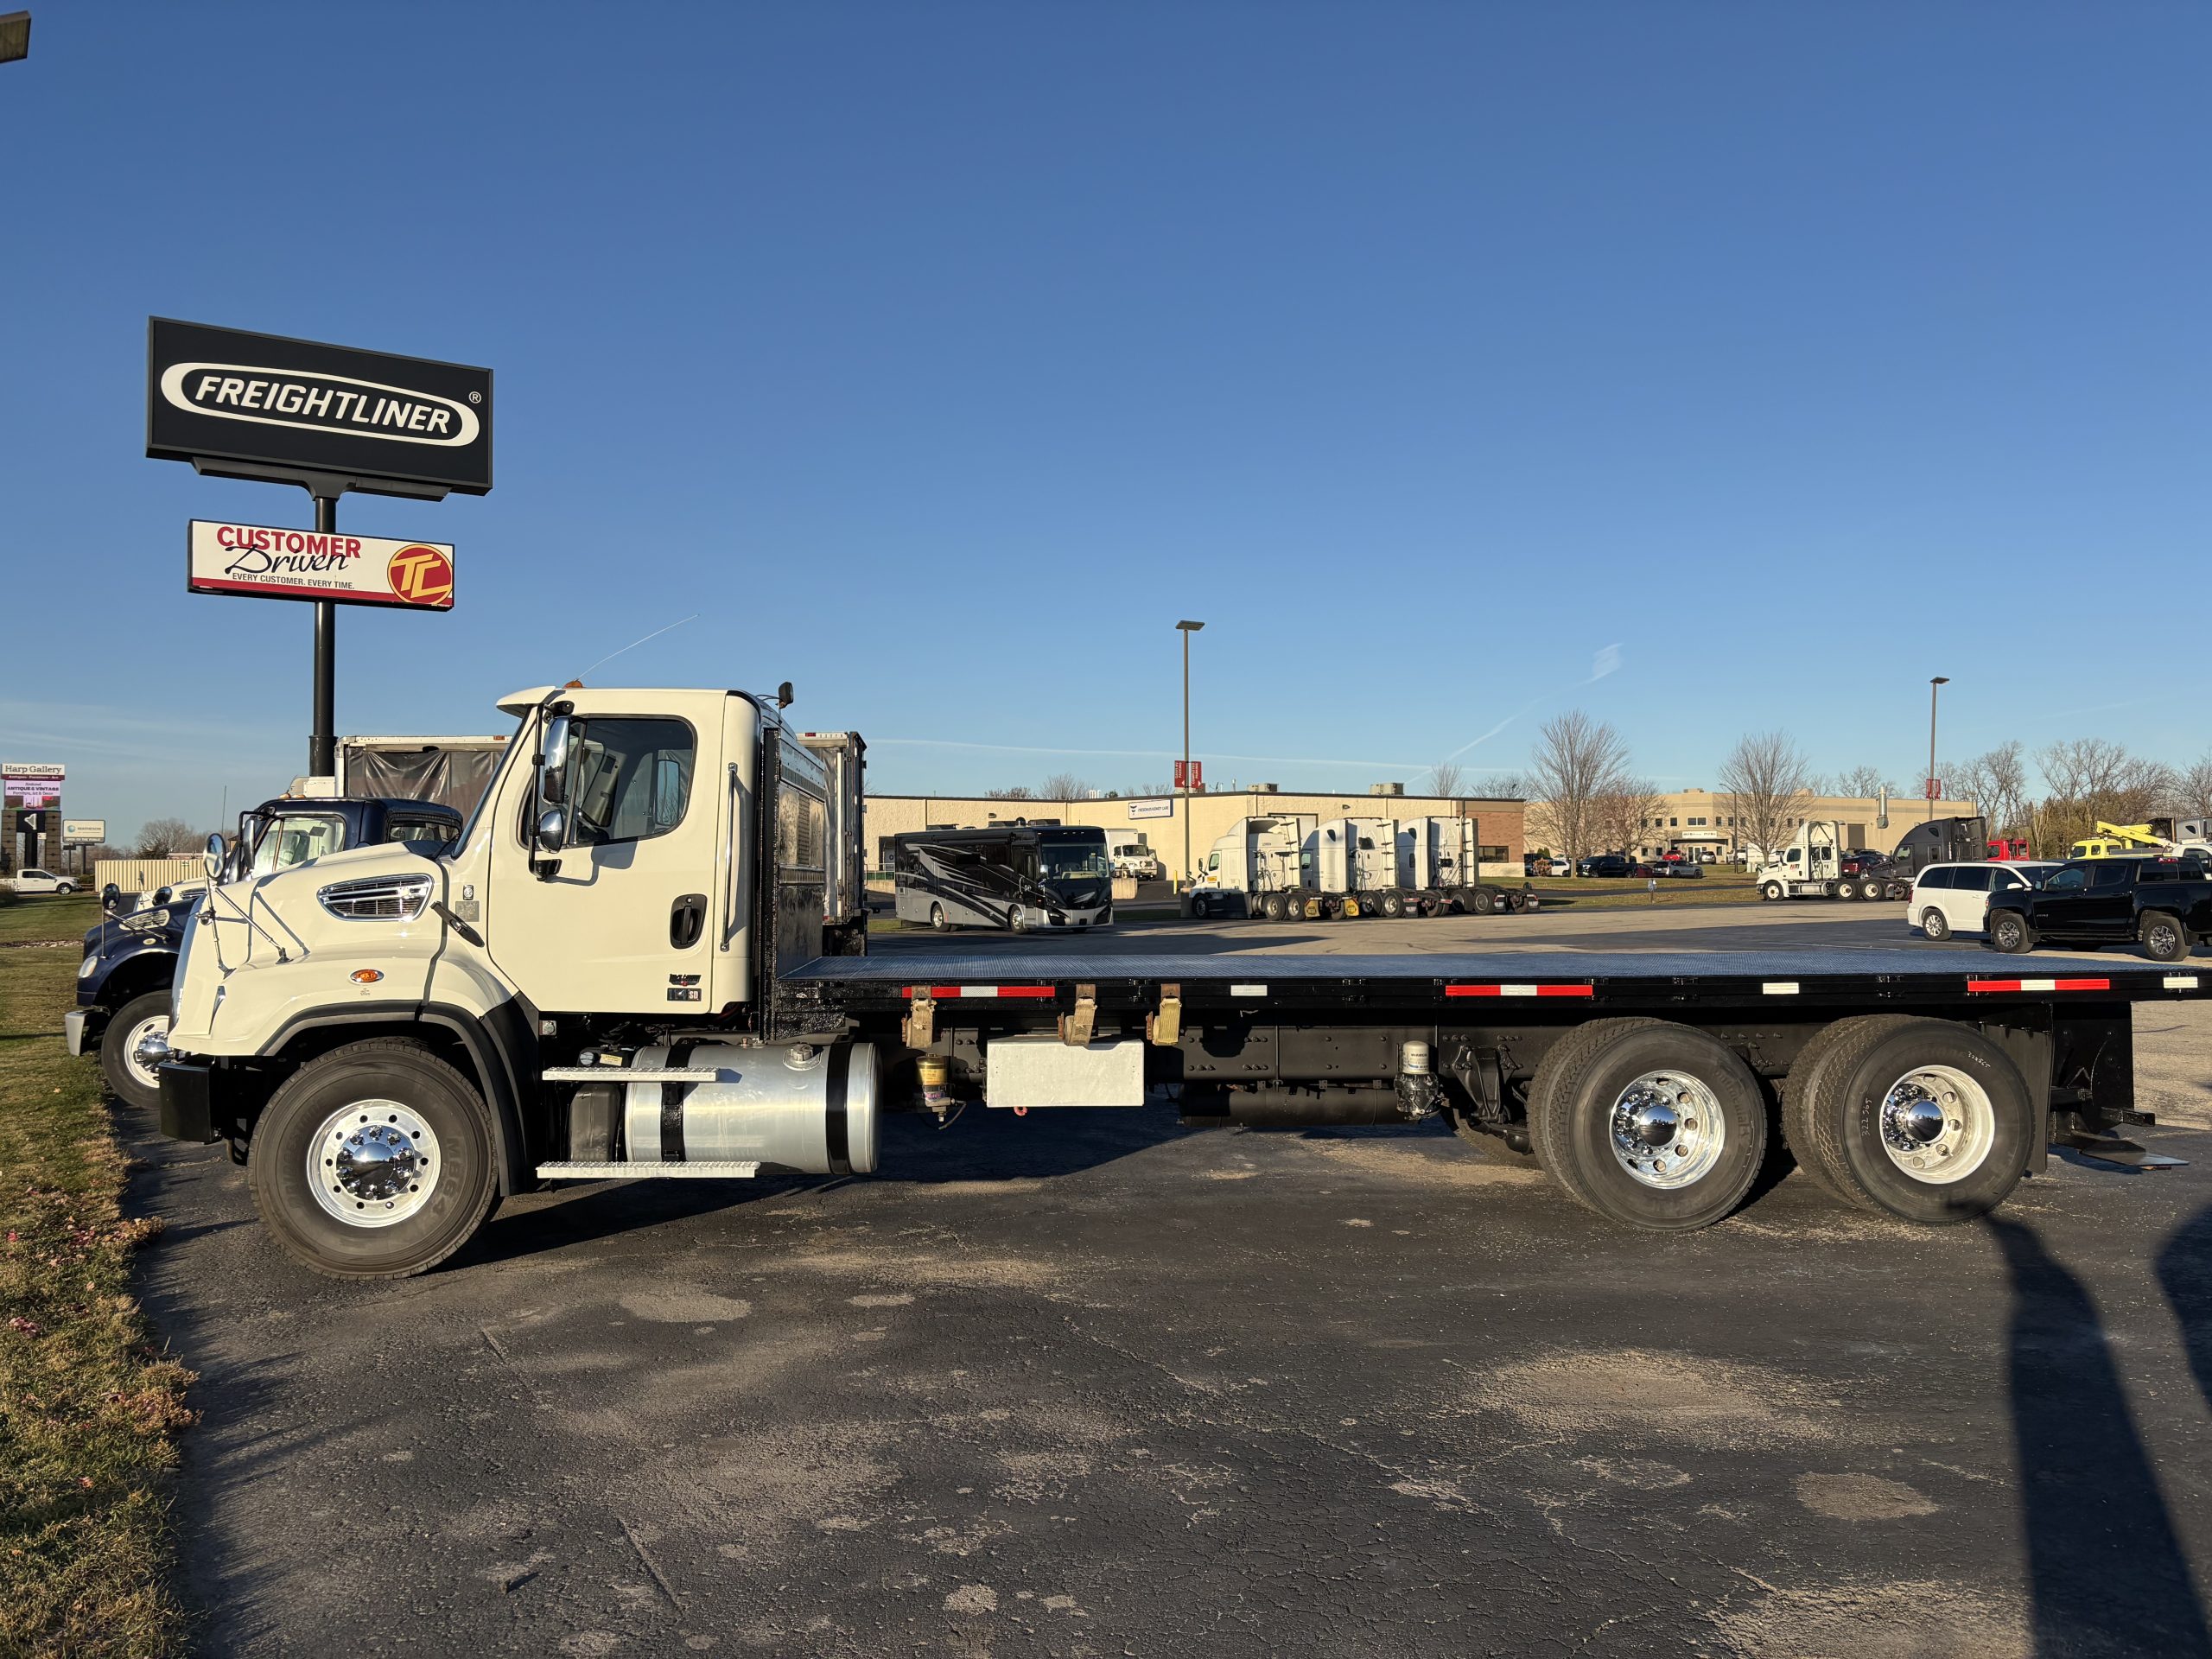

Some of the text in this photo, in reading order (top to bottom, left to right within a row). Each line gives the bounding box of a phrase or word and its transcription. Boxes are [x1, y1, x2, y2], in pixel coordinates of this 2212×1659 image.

[195, 376, 451, 434] FREIGHTLINER
[217, 526, 361, 558] CUSTOMER
[225, 543, 349, 575] Driven
[232, 572, 355, 590] EVERY CUSTOMER. EVERY TIME.
[5, 765, 61, 774] Harp Gallery
[689, 990, 698, 999] SD
